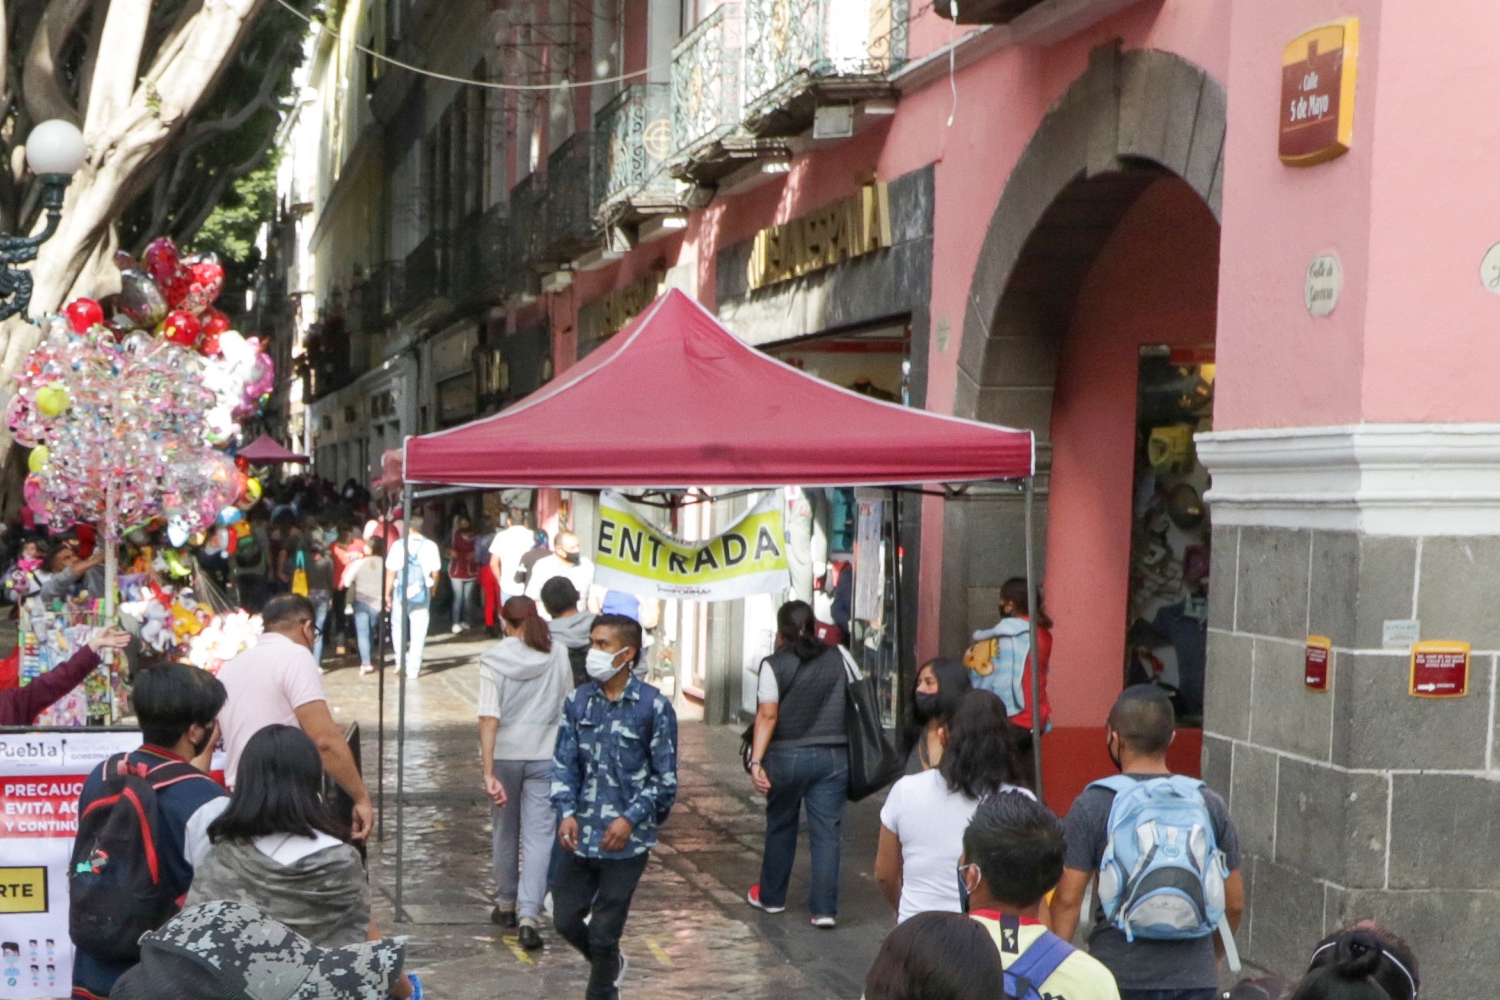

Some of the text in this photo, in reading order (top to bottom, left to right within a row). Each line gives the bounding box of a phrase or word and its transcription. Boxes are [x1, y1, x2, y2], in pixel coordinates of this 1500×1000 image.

[1297, 96, 1307, 119] de
[1308, 94, 1328, 119] Mayo
[598, 519, 781, 575] ENTRADA
[4, 783, 85, 798] PRECAUC
[4, 801, 54, 816] EVITA
[4, 818, 79, 833] Y CONTINÚ
